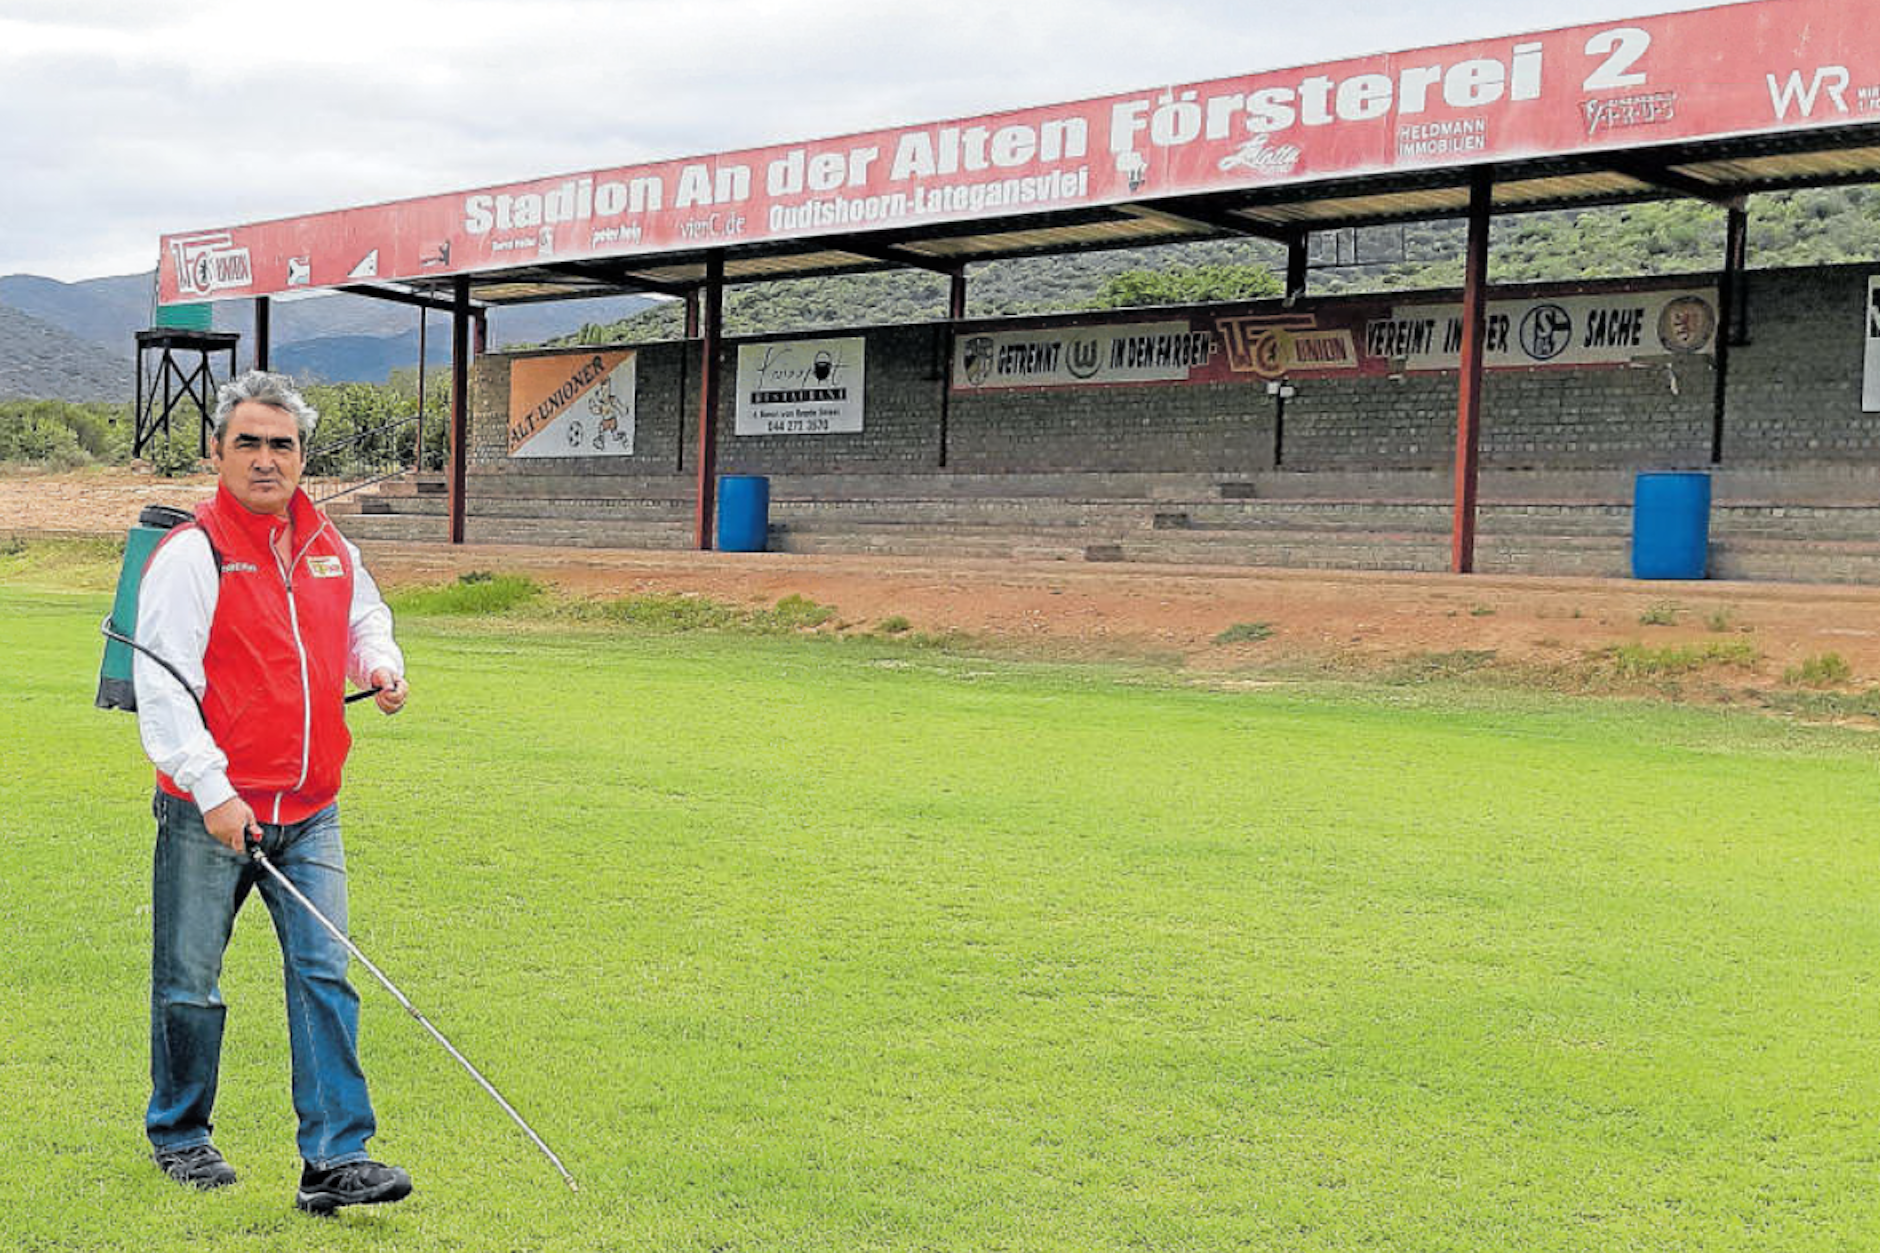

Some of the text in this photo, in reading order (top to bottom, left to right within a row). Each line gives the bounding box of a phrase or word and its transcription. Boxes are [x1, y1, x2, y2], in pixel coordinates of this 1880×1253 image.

[464, 177, 663, 235] Stadion
[675, 163, 751, 208] An
[766, 147, 879, 197] der
[890, 116, 1089, 181] Alten
[1109, 42, 1543, 153] Försterei
[1582, 27, 1651, 92] 2
[1399, 136, 1485, 156] IMMOBILIEN
[1400, 117, 1485, 141] HELDMANN
[1366, 318, 1435, 357] VEREINT
[1583, 307, 1645, 348] SACHE
[998, 340, 1062, 376] GETRENNT
